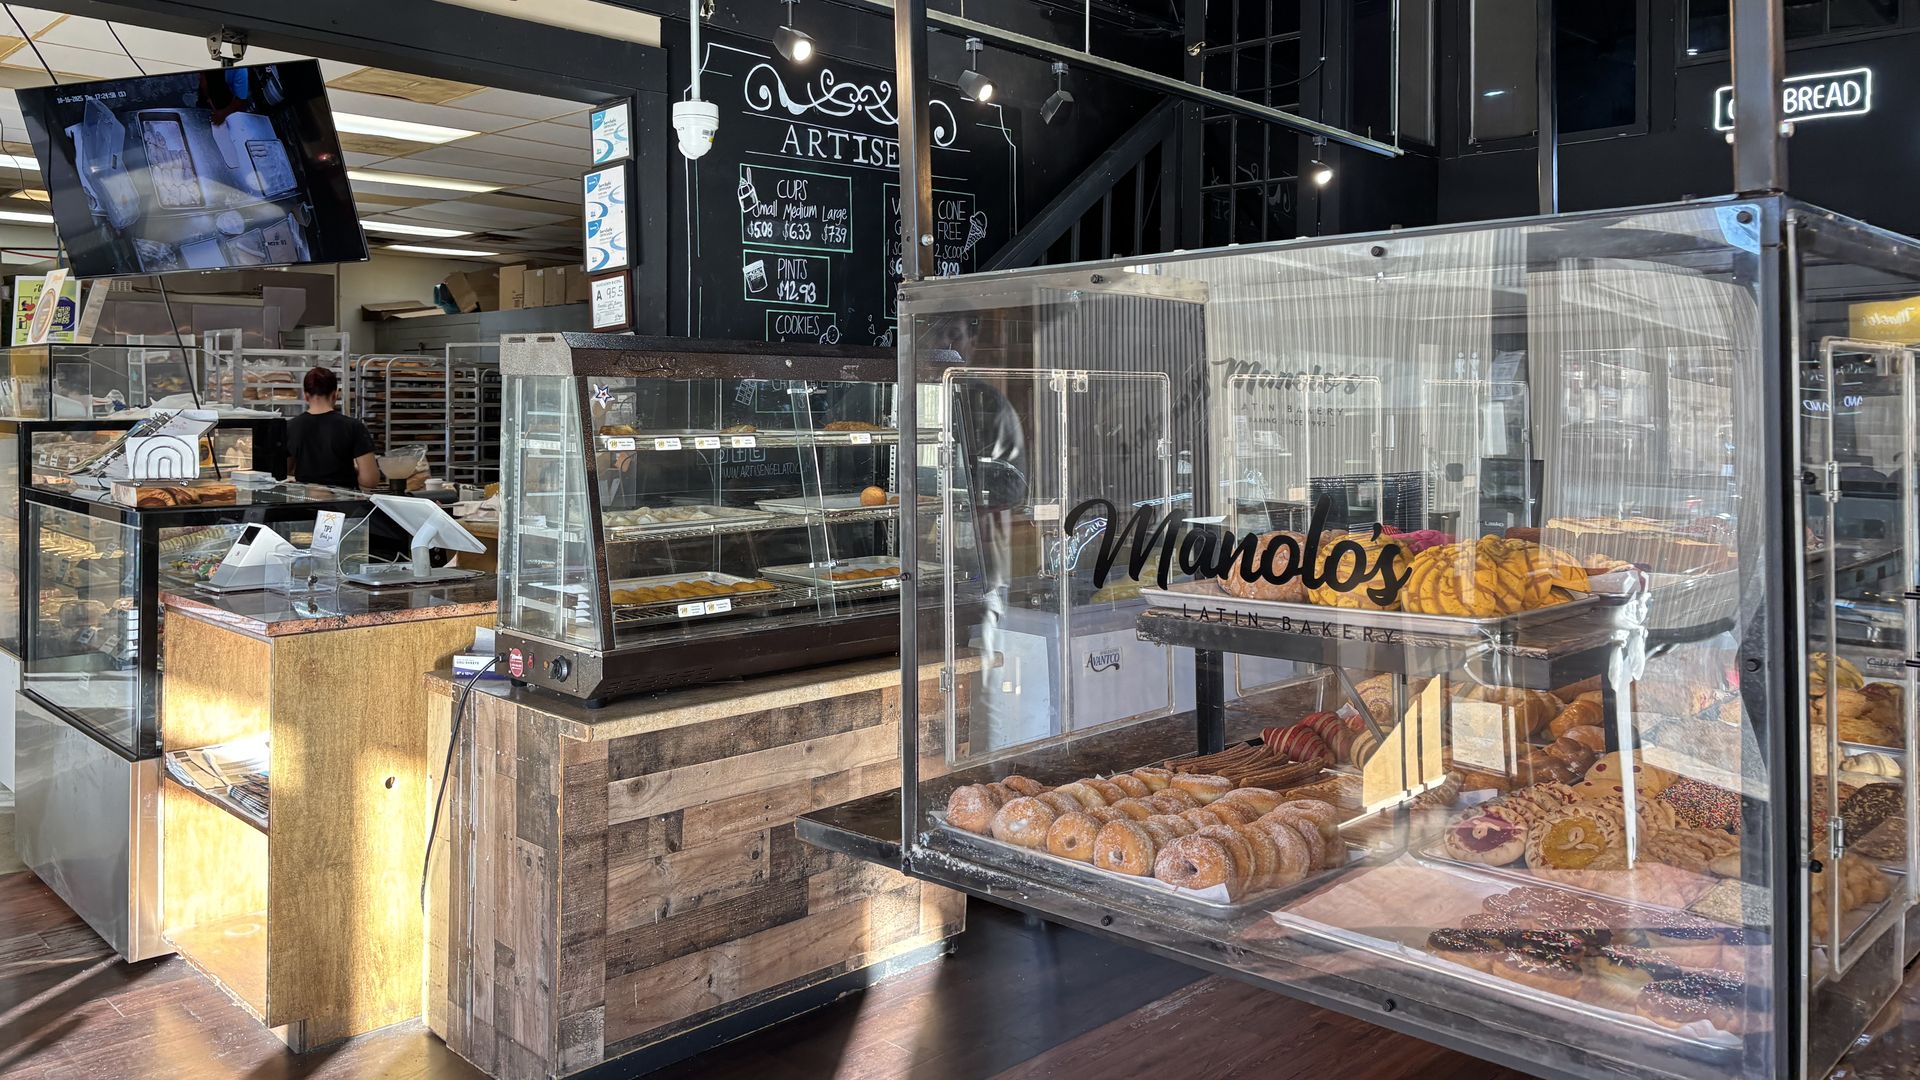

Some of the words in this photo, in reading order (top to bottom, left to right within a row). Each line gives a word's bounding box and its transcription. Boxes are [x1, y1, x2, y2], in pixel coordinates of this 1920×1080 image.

[1783, 80, 1861, 114] BREAD
[780, 124, 900, 168] ARTISE
[777, 179, 808, 201] CUPS
[752, 200, 778, 218] Small
[783, 203, 817, 221] Medium
[822, 205, 848, 226] Large
[937, 200, 967, 221] CONE
[937, 222, 963, 240] FREE
[777, 257, 808, 280] PINTS
[776, 281, 817, 304] $12.93
[775, 314, 820, 336] COOKIES
[1233, 402, 1276, 413] ATIN
[1064, 493, 1412, 606] Manolo's
[1183, 603, 1259, 627] LATIN
[1282, 616, 1395, 644] BAKERY
